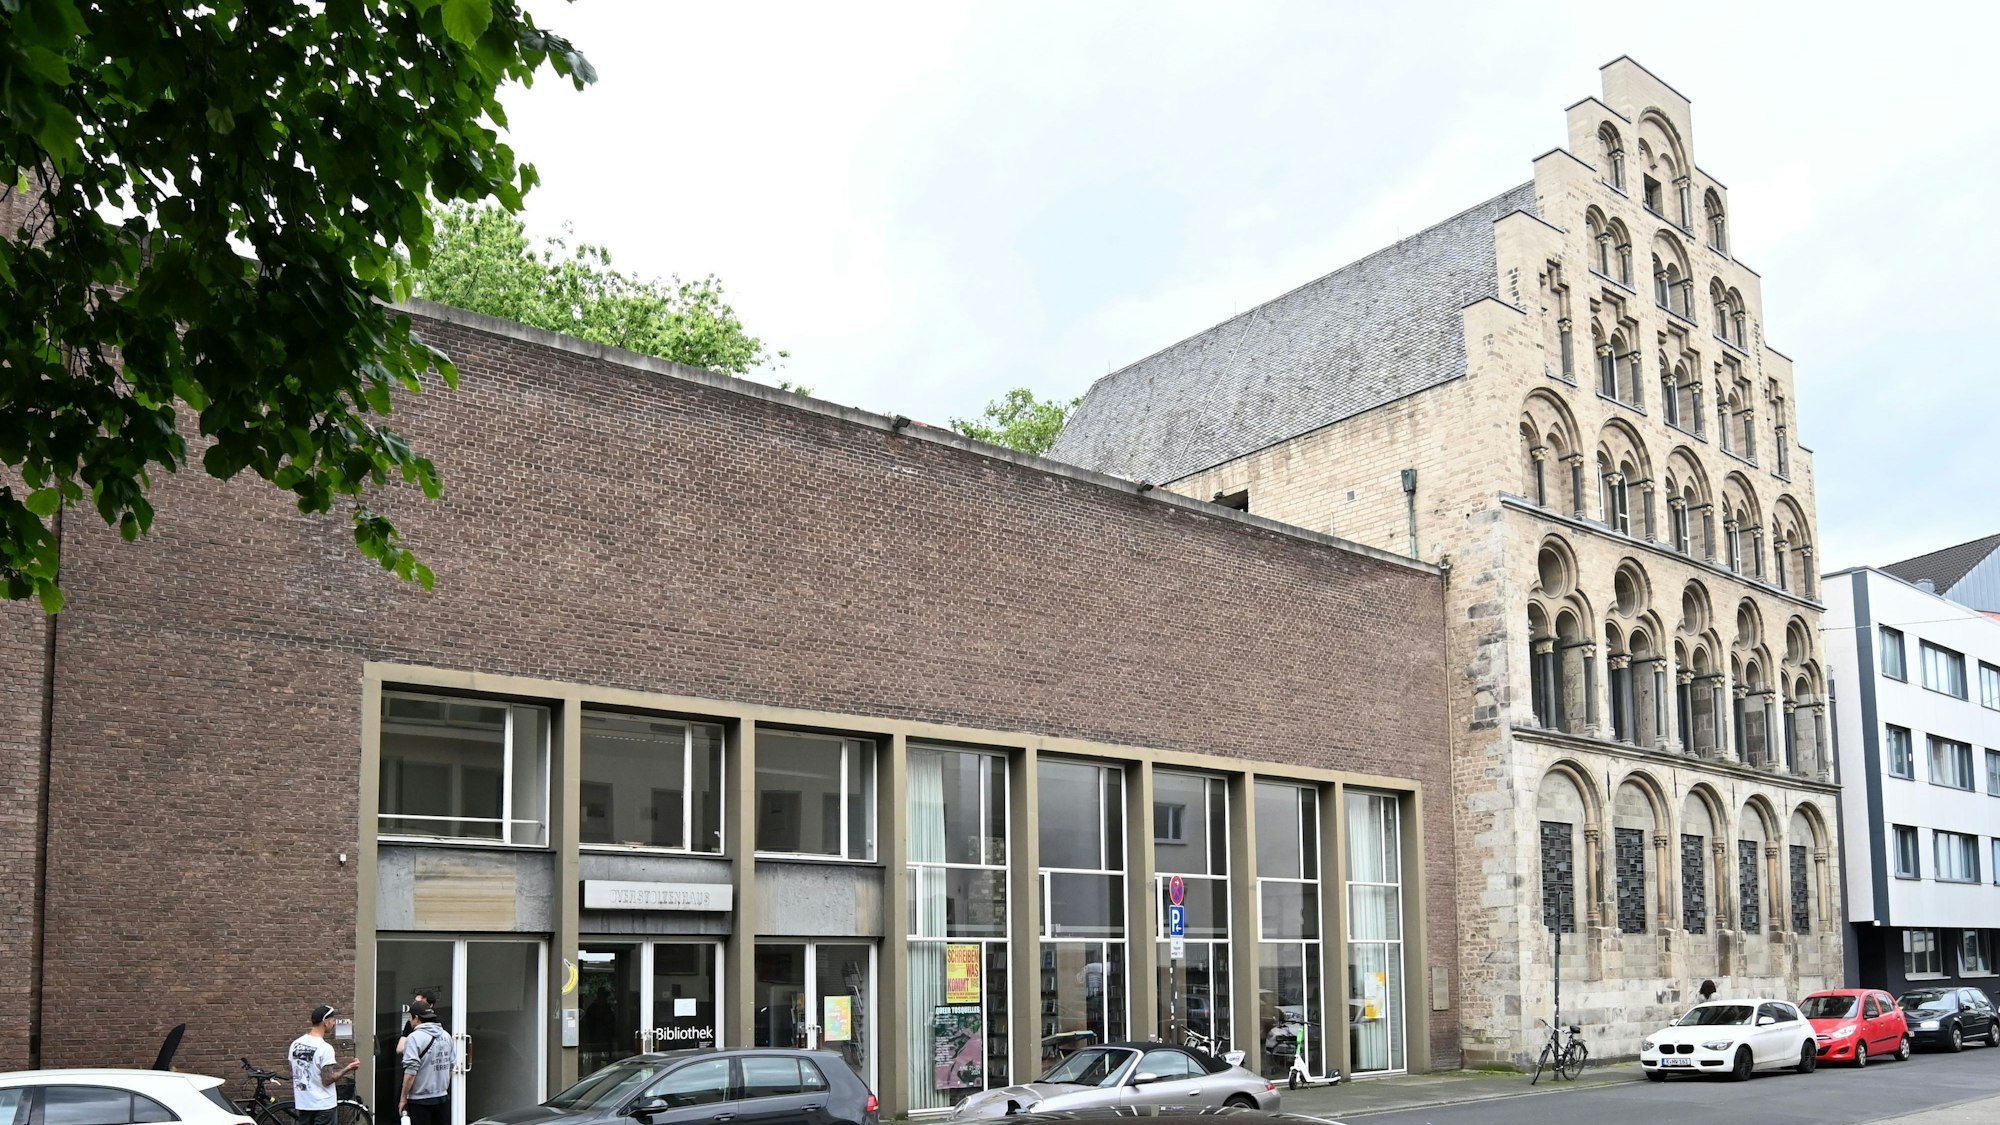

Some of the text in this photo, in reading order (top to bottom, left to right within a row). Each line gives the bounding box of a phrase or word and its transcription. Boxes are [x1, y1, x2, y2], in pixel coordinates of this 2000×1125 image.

[609, 889, 711, 905] OVERSTOLZENHAUS
[1172, 909, 1180, 932] P
[947, 949, 978, 963] SCHREIBEN
[965, 963, 978, 977] WAS
[947, 978, 969, 992] KOMMT
[656, 1025, 713, 1040] Bibliothek
